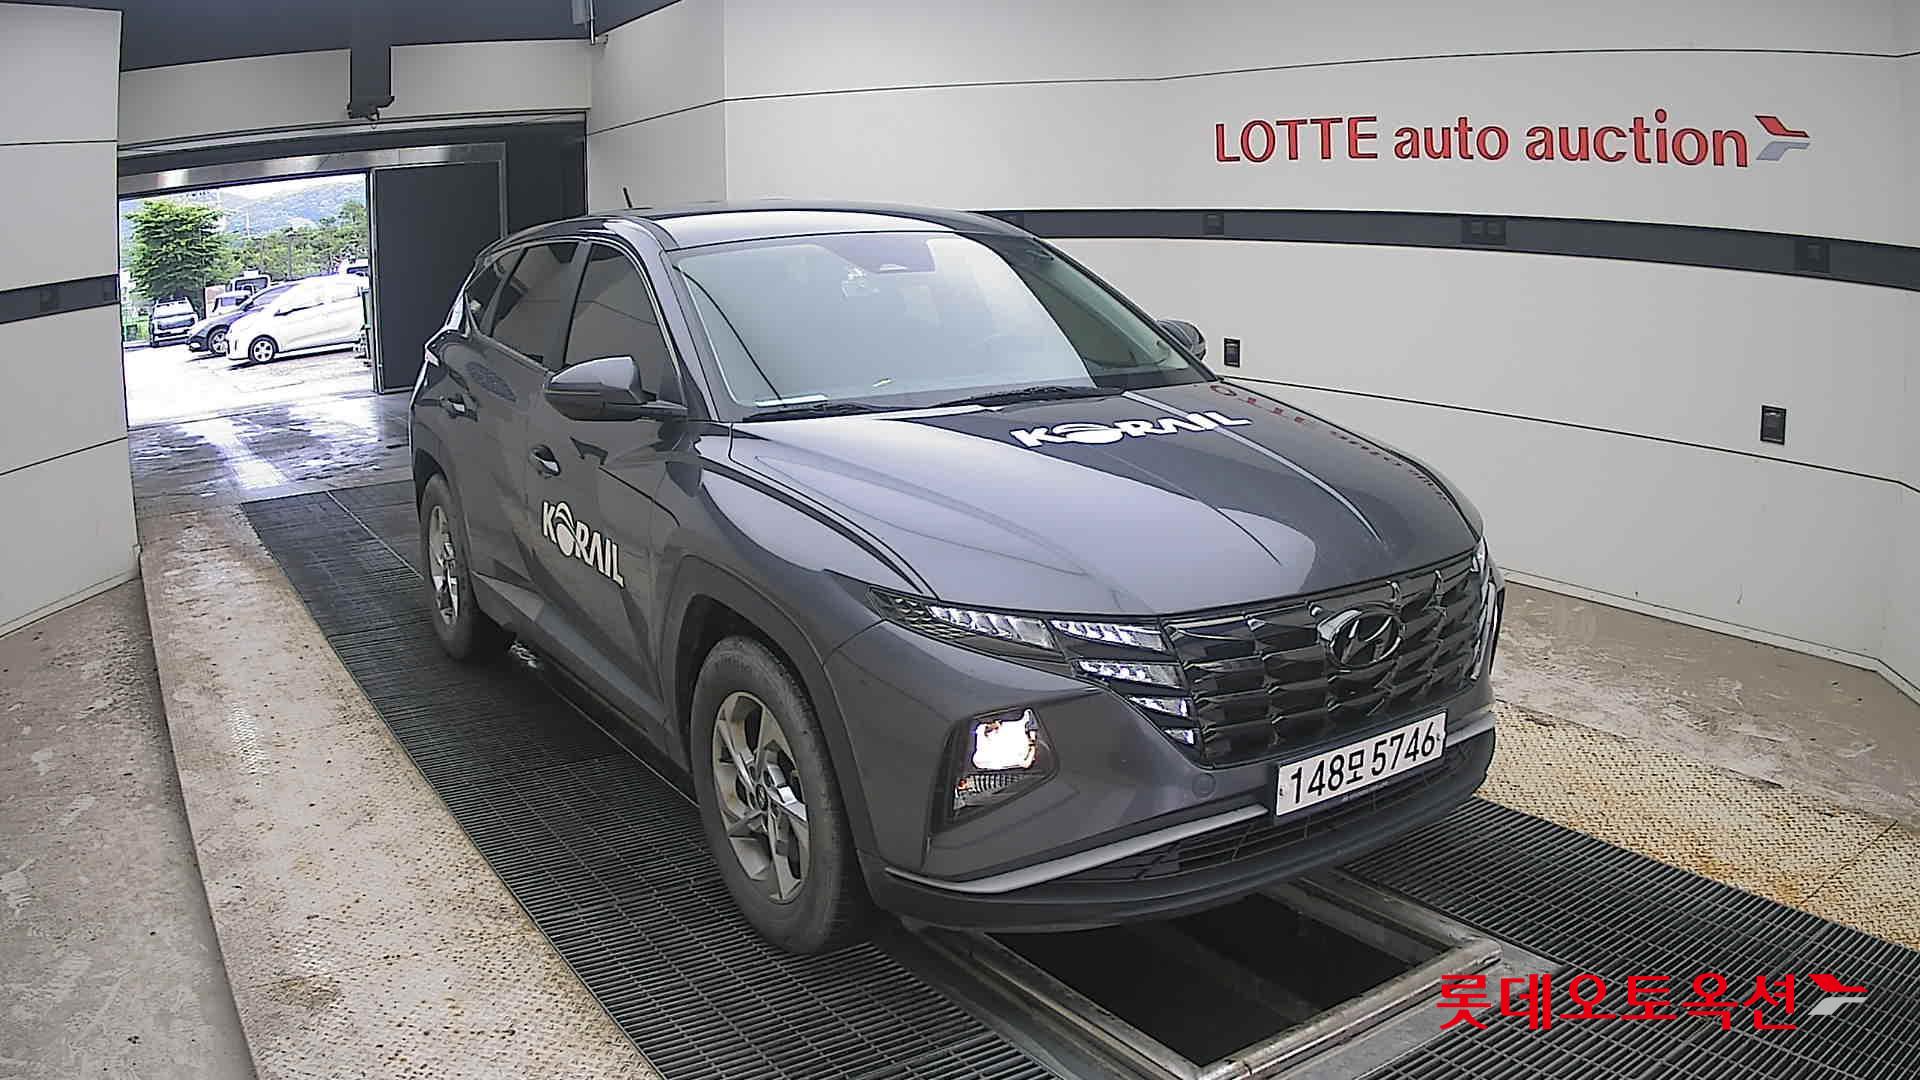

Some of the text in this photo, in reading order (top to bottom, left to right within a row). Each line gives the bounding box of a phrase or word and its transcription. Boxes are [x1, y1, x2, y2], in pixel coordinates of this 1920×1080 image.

[1215, 108, 1750, 168] LOTTE auto auction
[1010, 411, 1252, 447] KORAIL
[542, 500, 625, 588] KORAIL
